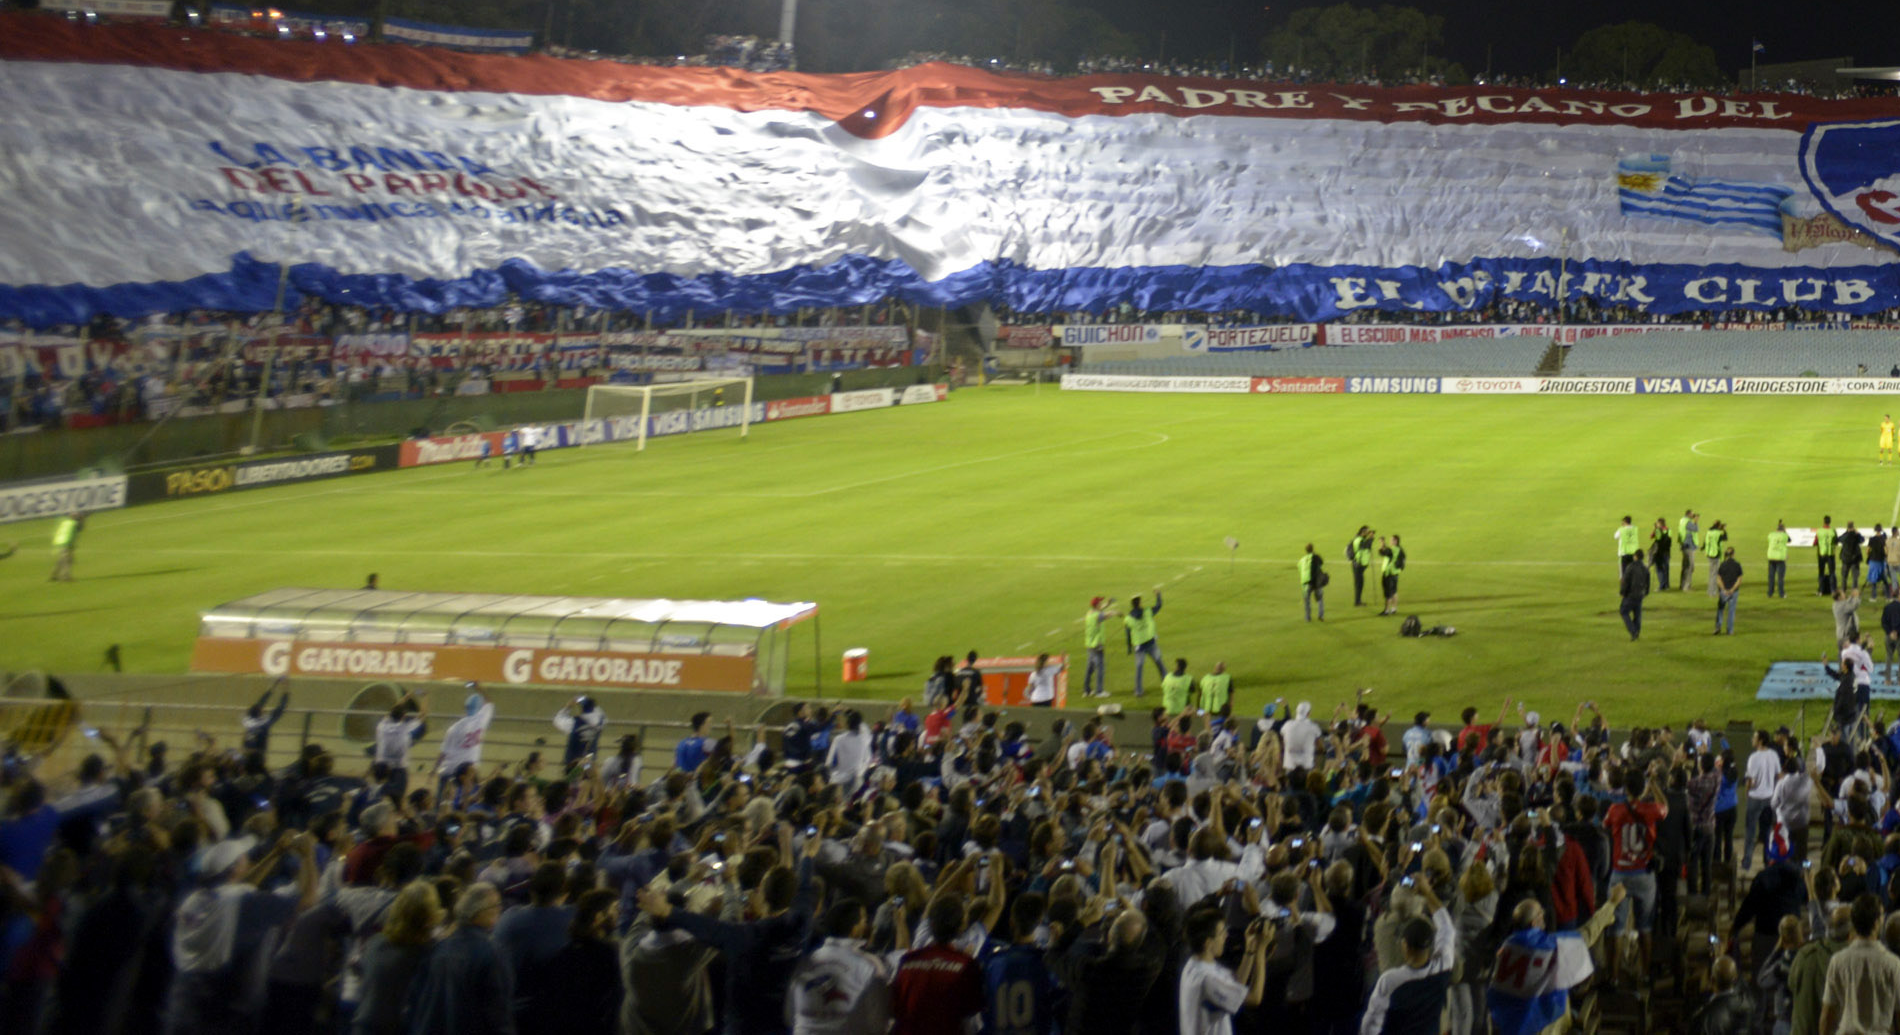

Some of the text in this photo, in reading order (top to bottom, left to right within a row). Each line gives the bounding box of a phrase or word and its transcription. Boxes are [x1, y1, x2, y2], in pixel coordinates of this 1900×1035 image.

[1090, 85, 1314, 108] PADRE
[1328, 92, 1373, 110] Y
[1675, 96, 1792, 120] DEL
[1685, 274, 1875, 308] CLUB
[1064, 325, 1144, 345] GUICHON
[1207, 325, 1310, 348] PORTEZUELO
[1341, 327, 1355, 343] EL
[1358, 327, 1406, 343] ESCUDO
[1410, 327, 1437, 343] MAS
[1271, 379, 1339, 394] Santander
[1351, 377, 1438, 394] SAMSUNG
[1476, 380, 1523, 391] TOYOTA
[1539, 379, 1633, 393] BRIDGESTONE
[1641, 377, 1730, 393] VISA VISA
[1734, 379, 1828, 393] BRIDGESTONE
[1847, 381, 1875, 391] COPA
[298, 647, 435, 675] GATORADE
[539, 655, 682, 685] GATORADE
[996, 979, 1036, 1027] 10
